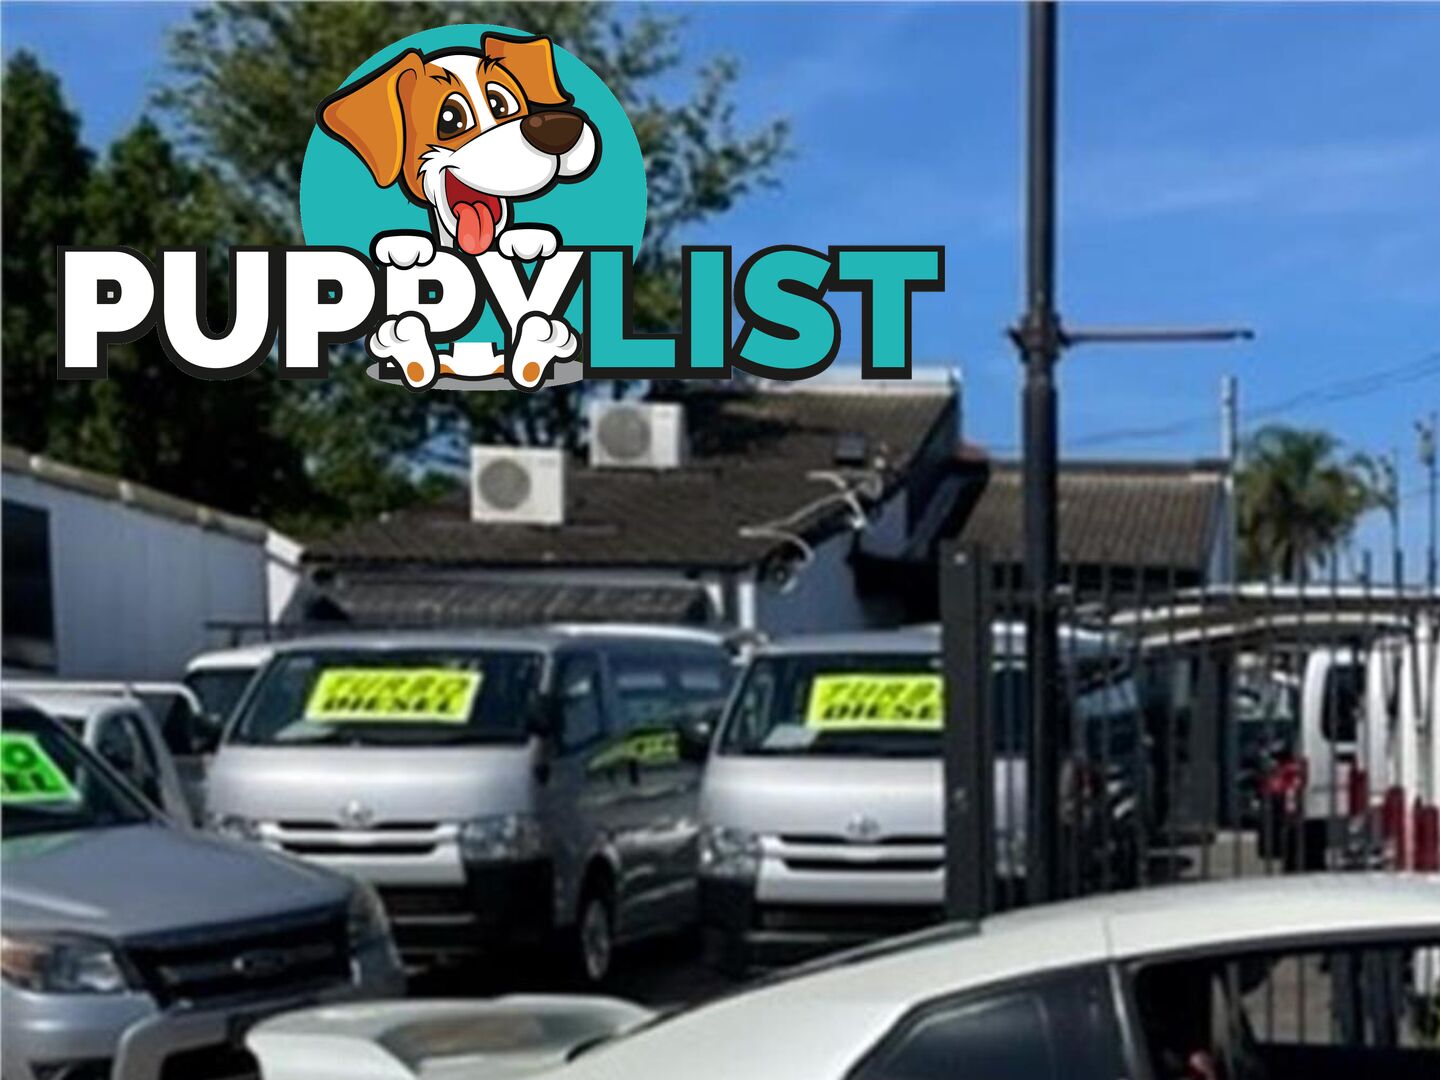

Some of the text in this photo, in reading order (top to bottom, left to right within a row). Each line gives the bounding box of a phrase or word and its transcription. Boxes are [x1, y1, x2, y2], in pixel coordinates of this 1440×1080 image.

[828, 683, 938, 704] TURB
[322, 696, 460, 713] DIESEL
[822, 704, 936, 721] DIESE
